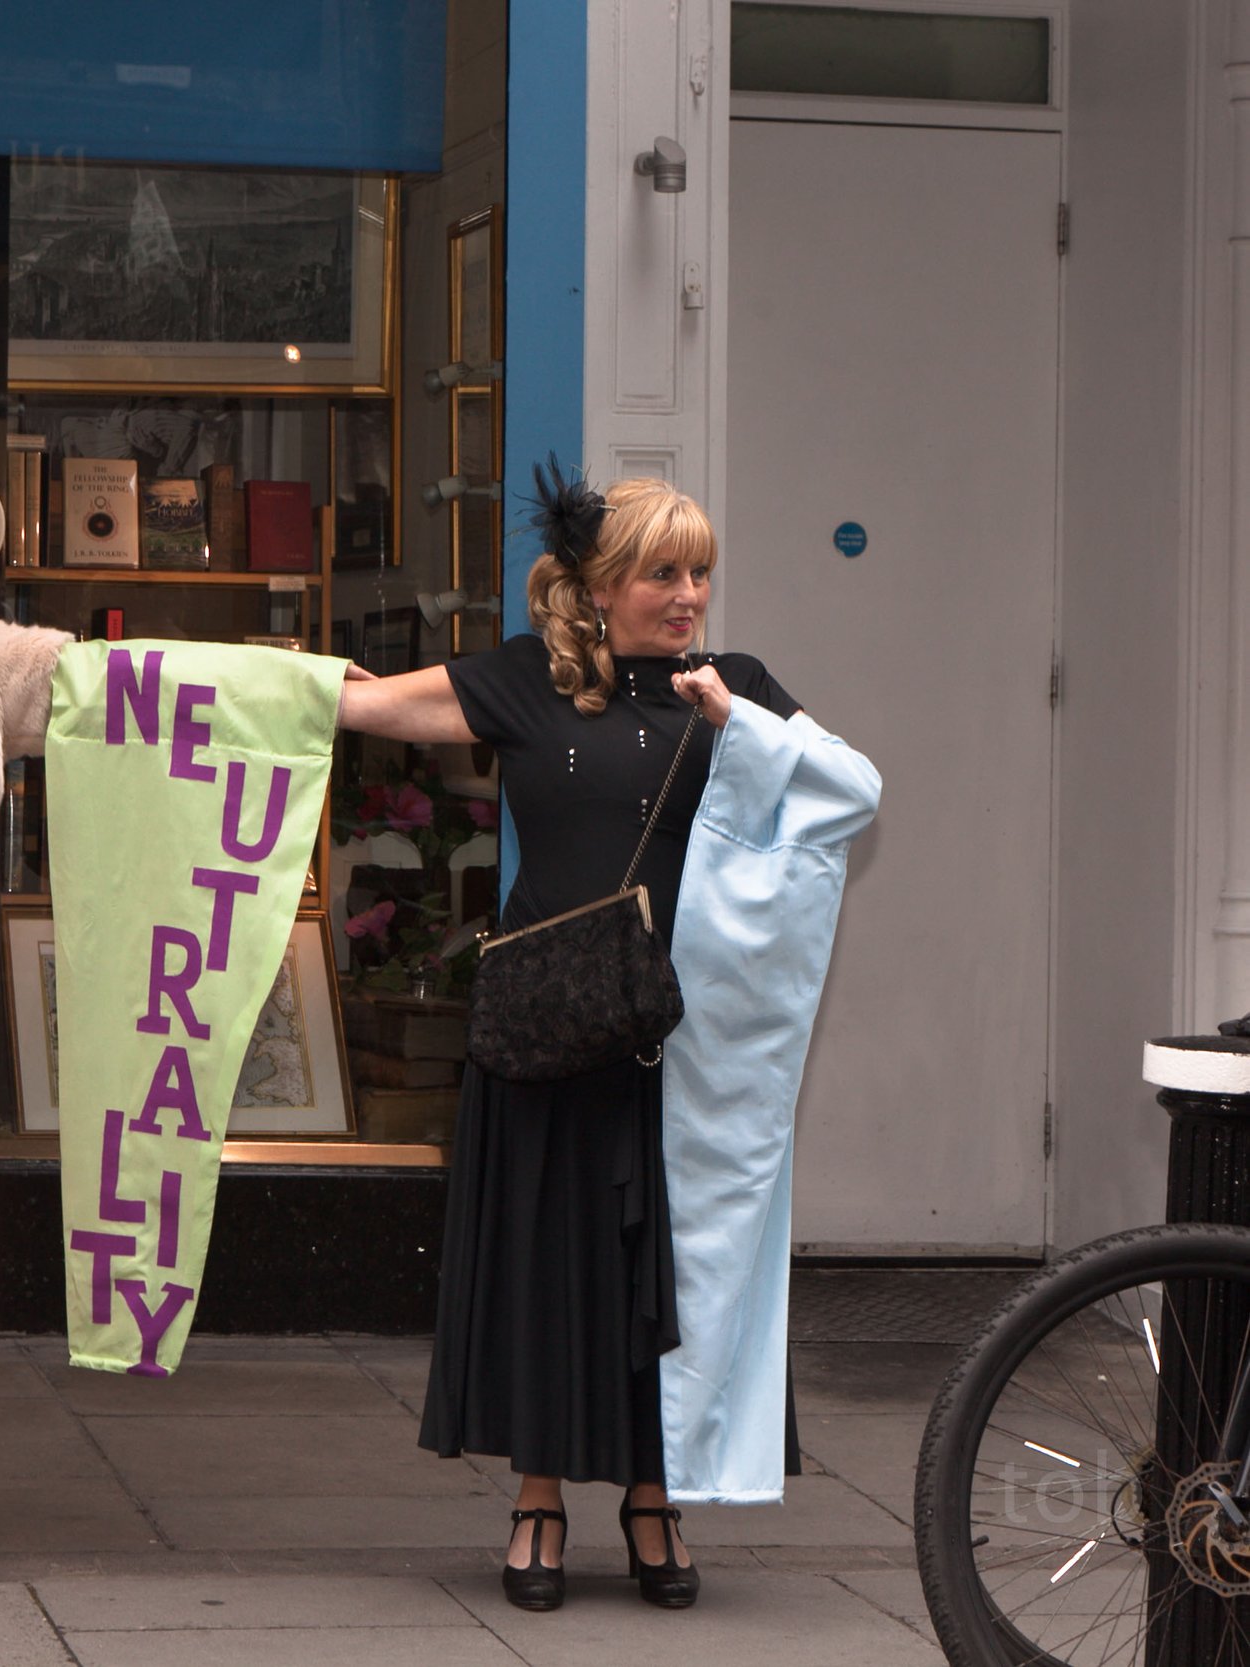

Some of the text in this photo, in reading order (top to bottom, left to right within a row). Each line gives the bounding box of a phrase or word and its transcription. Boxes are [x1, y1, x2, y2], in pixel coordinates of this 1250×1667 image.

[73, 474, 129, 483] FELLOWSHIP
[87, 484, 103, 492] THE
[70, 648, 292, 1378] NEUTRALITY
